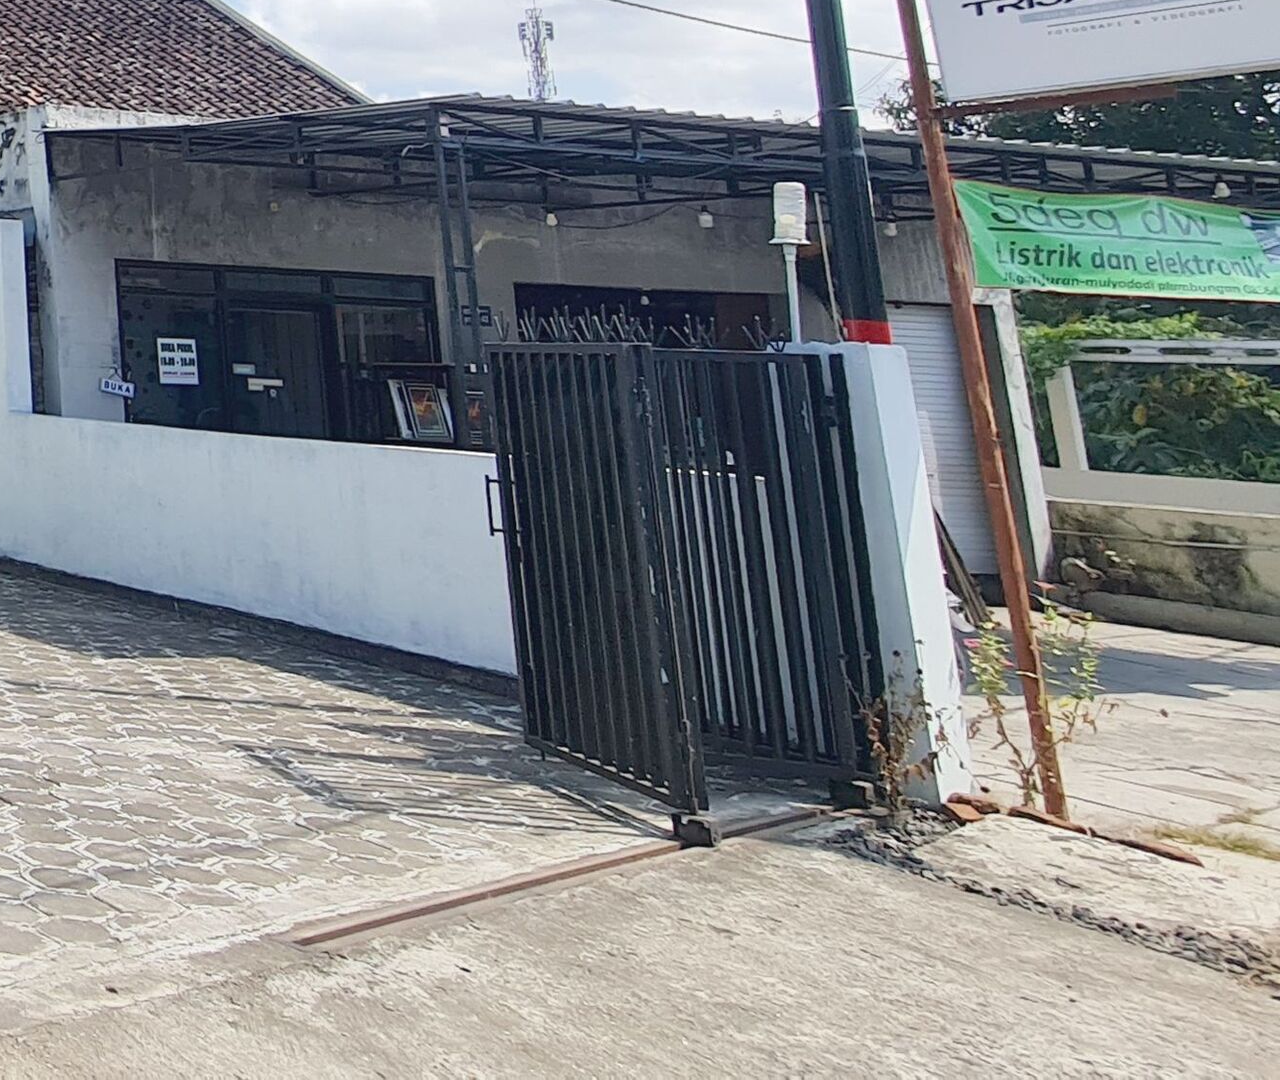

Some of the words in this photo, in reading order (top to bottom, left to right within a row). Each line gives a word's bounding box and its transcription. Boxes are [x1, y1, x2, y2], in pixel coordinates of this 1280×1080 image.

[996, 241, 1082, 268] Listrik
[1091, 245, 1138, 271] dan
[1145, 249, 1270, 279] elektronik
[104, 380, 131, 393] BUKA
